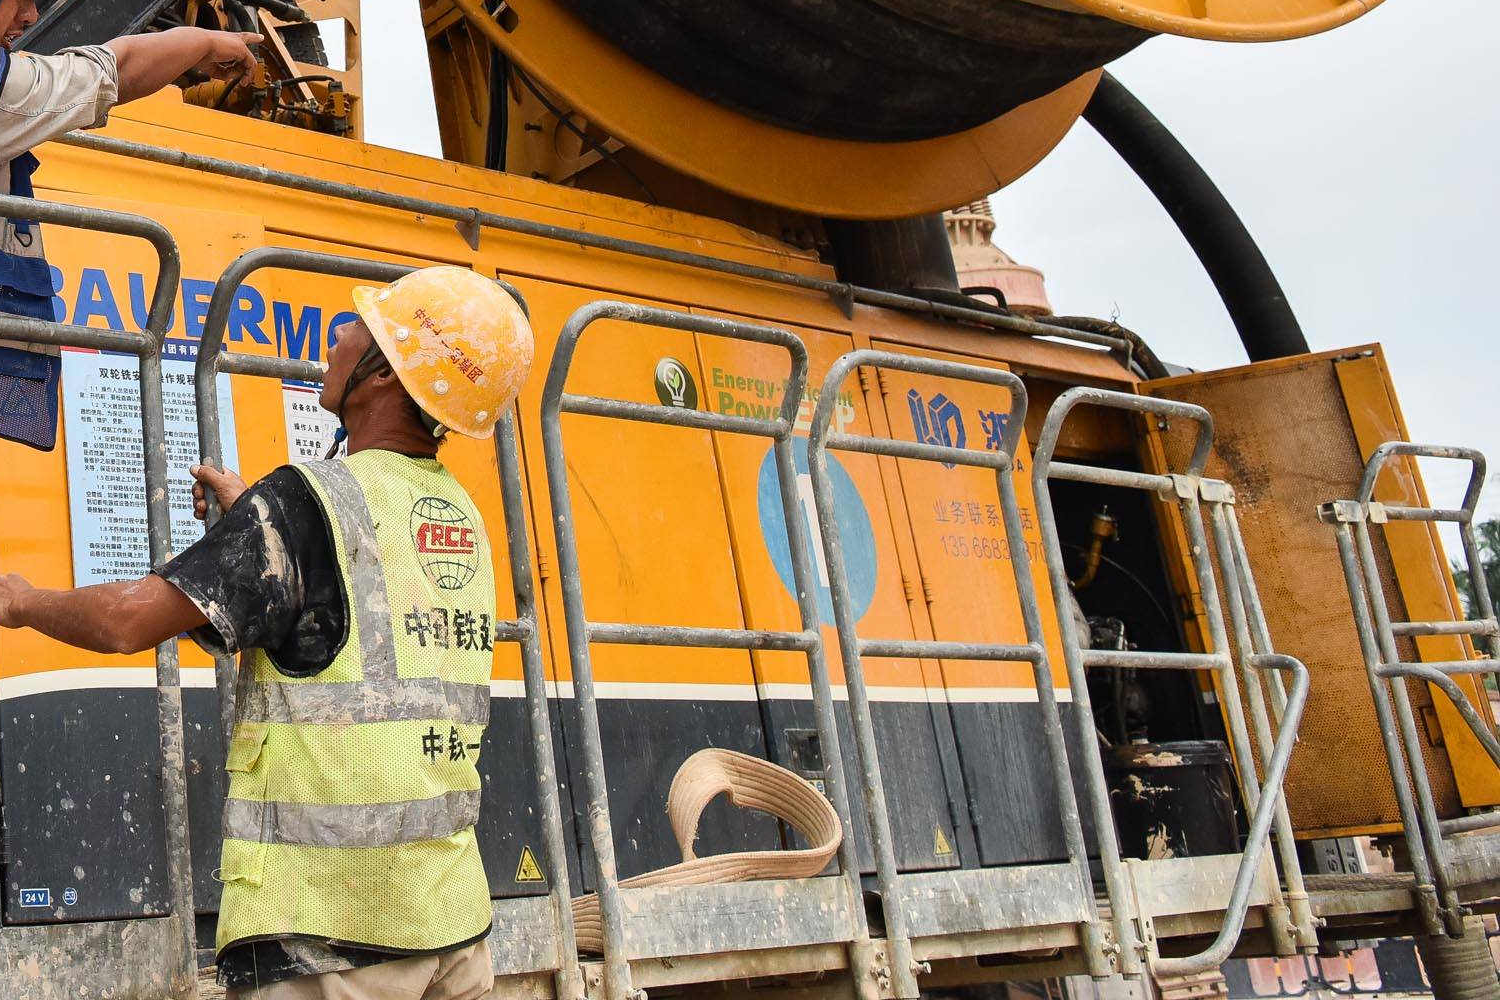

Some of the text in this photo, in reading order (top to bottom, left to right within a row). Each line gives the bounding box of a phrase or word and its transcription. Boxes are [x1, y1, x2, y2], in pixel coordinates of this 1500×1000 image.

[291, 402, 319, 413] 设备名称
[293, 422, 320, 433] 操作人员
[933, 500, 1033, 530] 业务联系话
[940, 535, 969, 558] 135
[25, 893, 45, 903] 24 V
